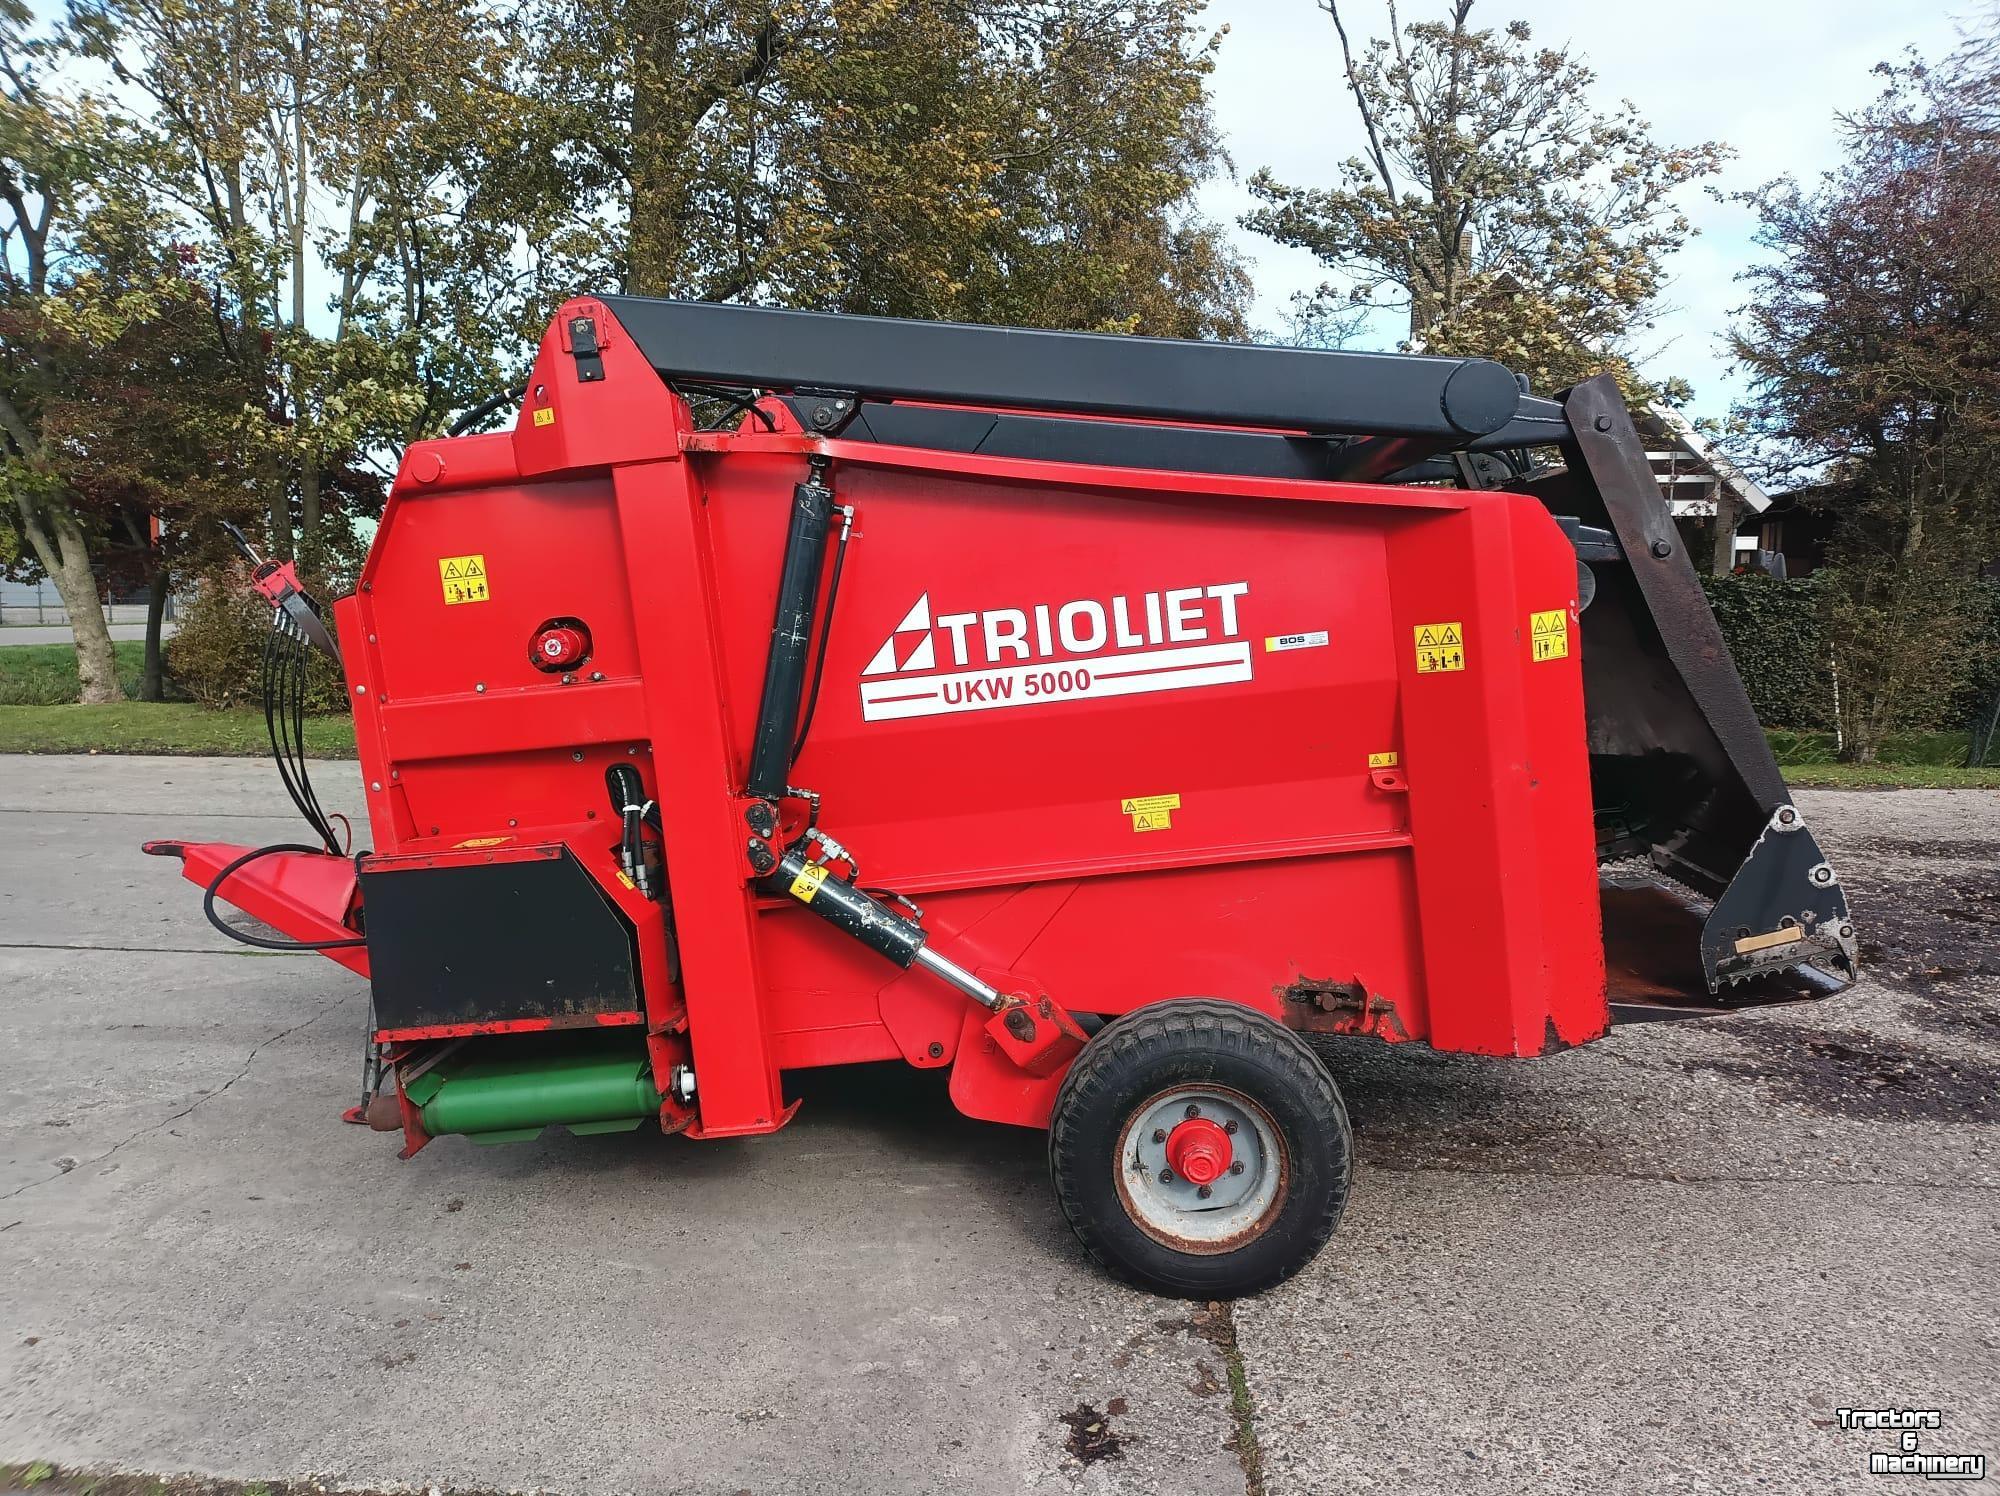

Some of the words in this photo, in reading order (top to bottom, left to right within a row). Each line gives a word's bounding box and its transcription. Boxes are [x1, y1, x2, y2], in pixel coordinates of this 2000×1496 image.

[937, 582, 1249, 666] TRIOLIET
[1279, 636, 1305, 645] BOS
[943, 677, 1013, 704] UKW
[1024, 668, 1091, 696] 5000
